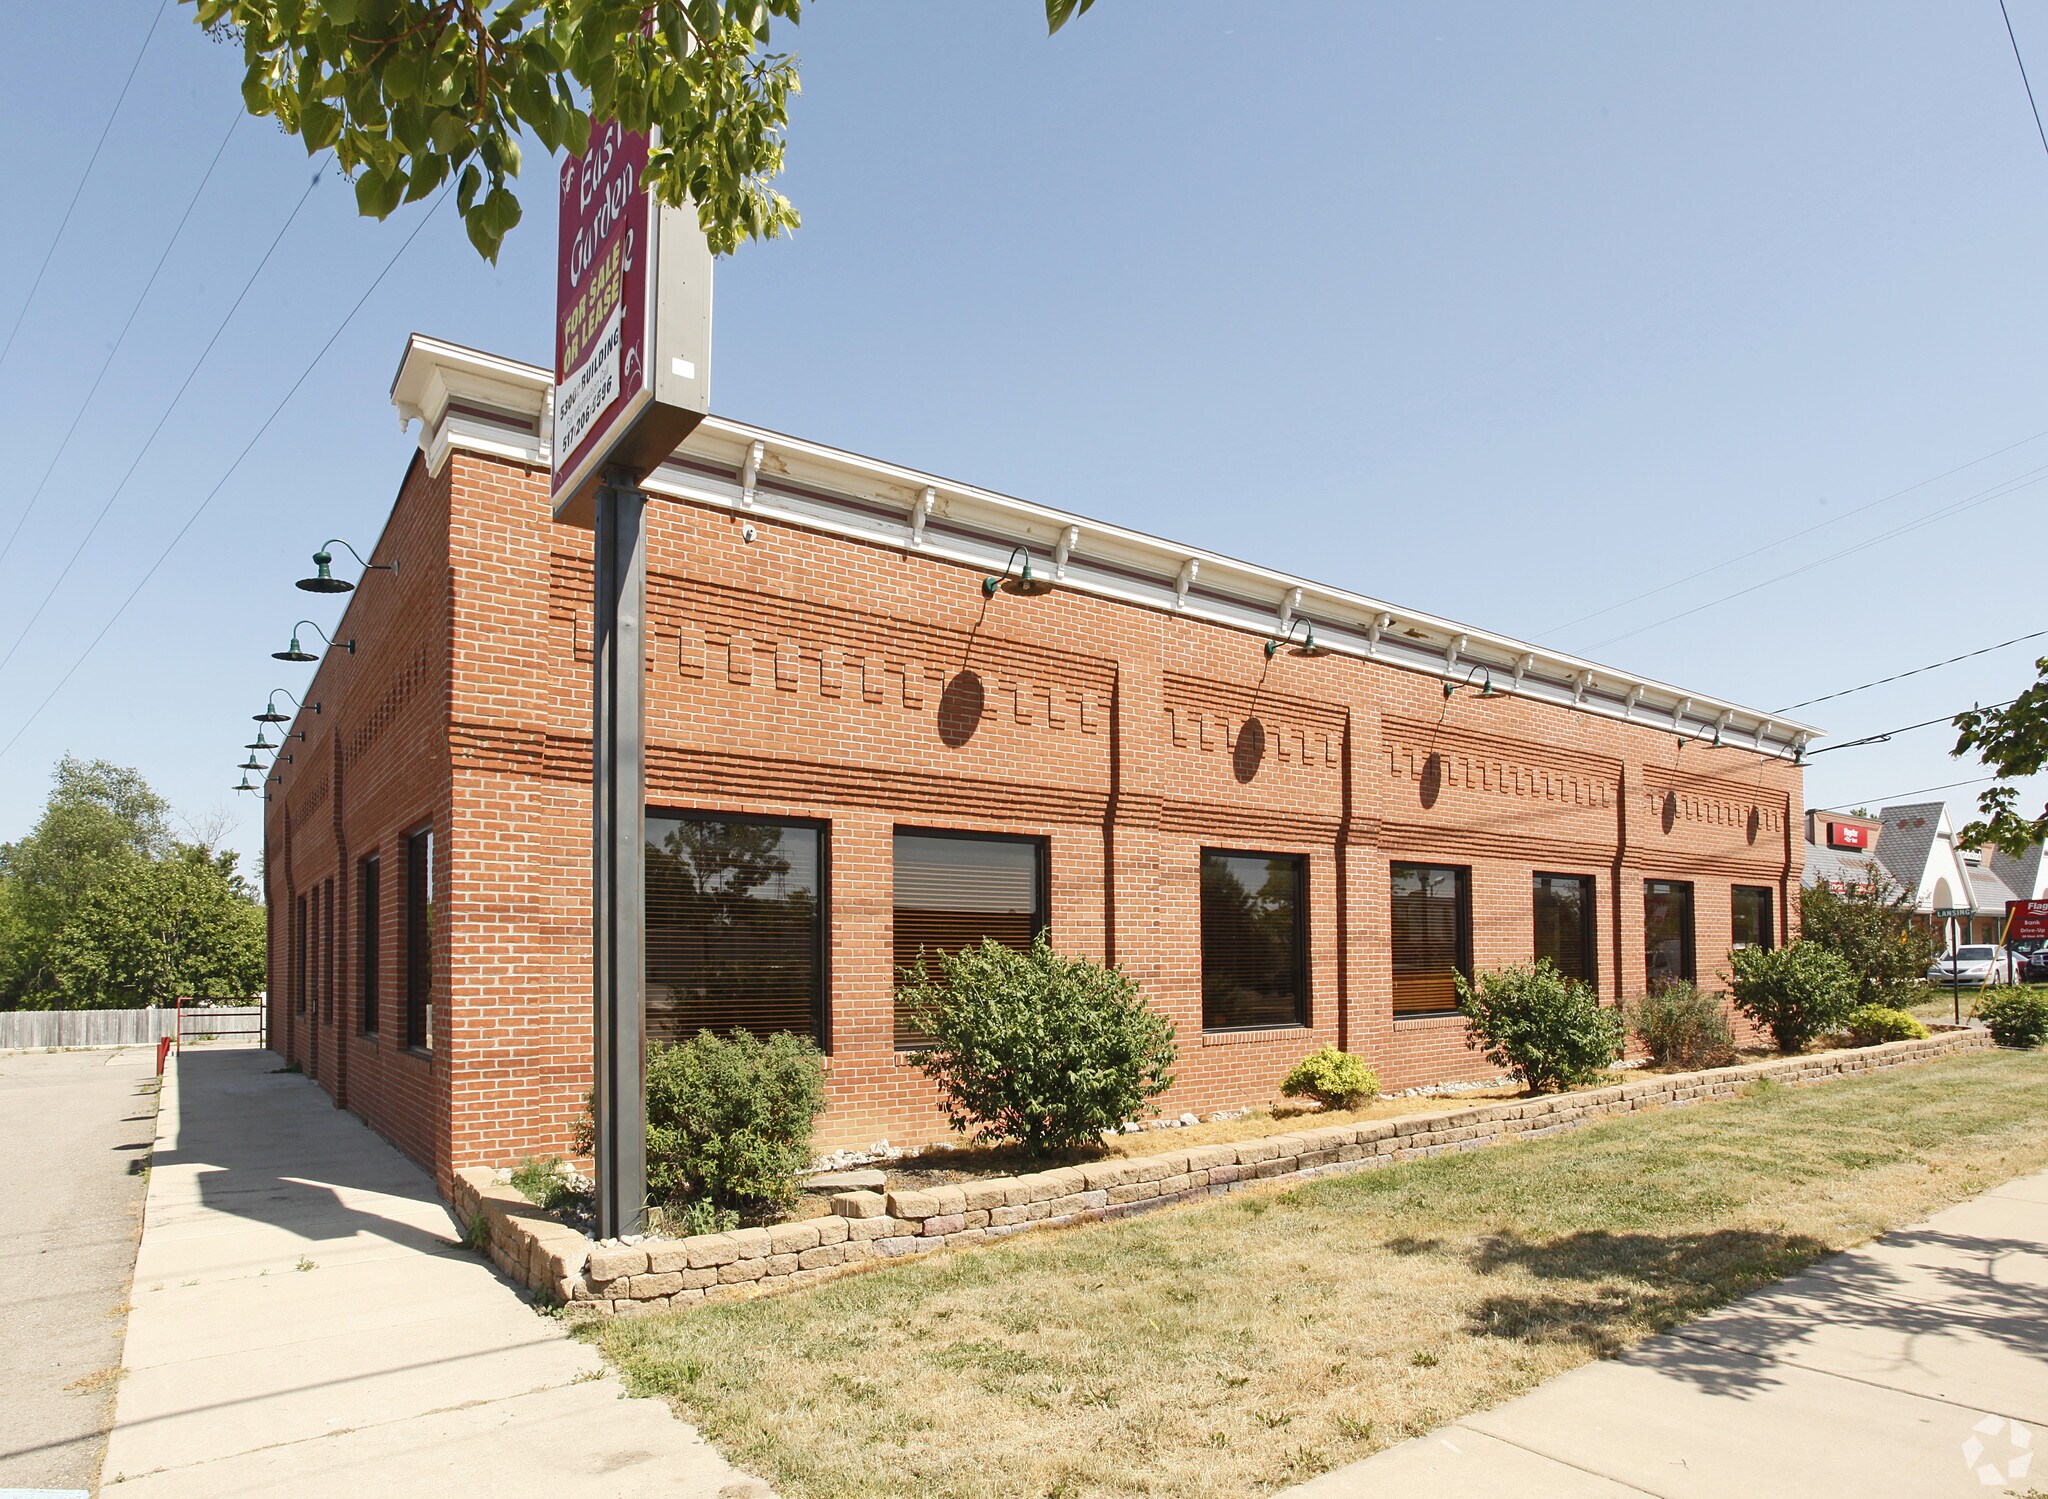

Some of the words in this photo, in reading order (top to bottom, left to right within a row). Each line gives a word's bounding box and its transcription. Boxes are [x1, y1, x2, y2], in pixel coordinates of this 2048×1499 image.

[570, 162, 634, 288] Garden
[563, 333, 579, 374] OR
[581, 270, 620, 349] LEASE
[564, 293, 587, 346] FOR
[589, 238, 620, 307] SALE
[581, 326, 620, 392] BUILDING
[1937, 908, 1971, 918] LANSING
